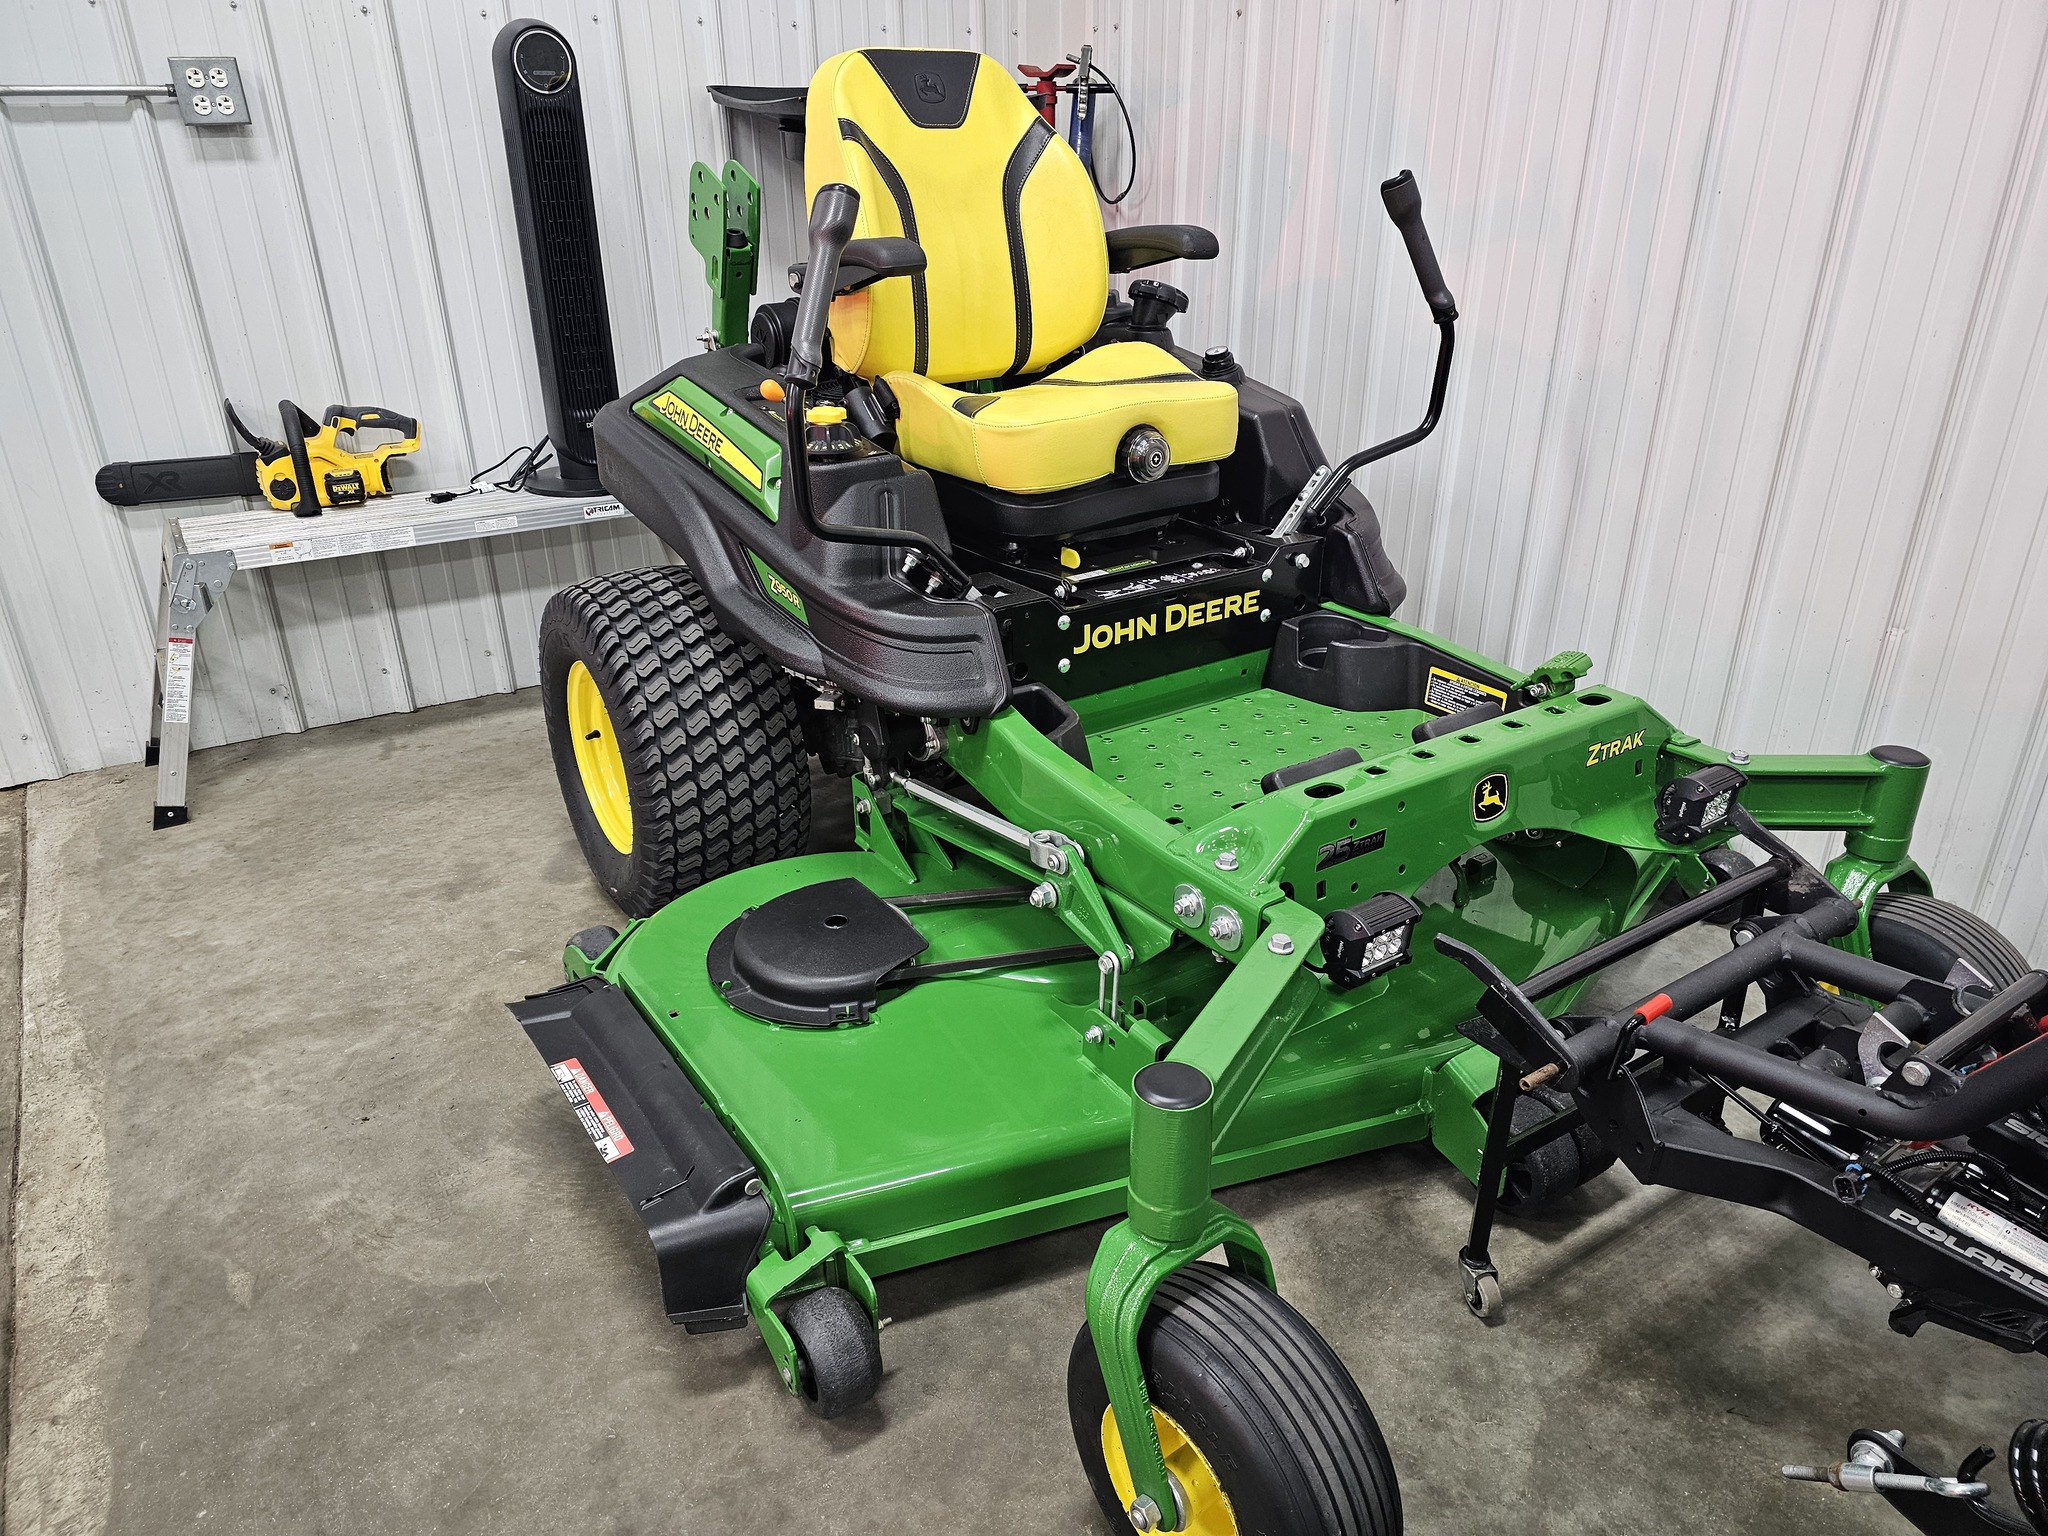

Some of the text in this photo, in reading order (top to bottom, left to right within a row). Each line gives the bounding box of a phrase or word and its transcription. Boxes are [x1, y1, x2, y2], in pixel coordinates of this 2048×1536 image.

[660, 396, 724, 455] JOHN DEERE
[140, 470, 180, 494] XR
[593, 504, 620, 513] TRICAM
[768, 574, 801, 609] Z950R
[1074, 590, 1261, 655] JOHN DEERE
[1586, 729, 1646, 767] ZTRAK
[1315, 833, 1384, 872] 25 ZTRAK
[574, 1072, 595, 1095] DANGER
[603, 1116, 624, 1142] PELIGRO
[1967, 1202, 1990, 1217] KYB
[1889, 1208, 2048, 1298] POLARIS
